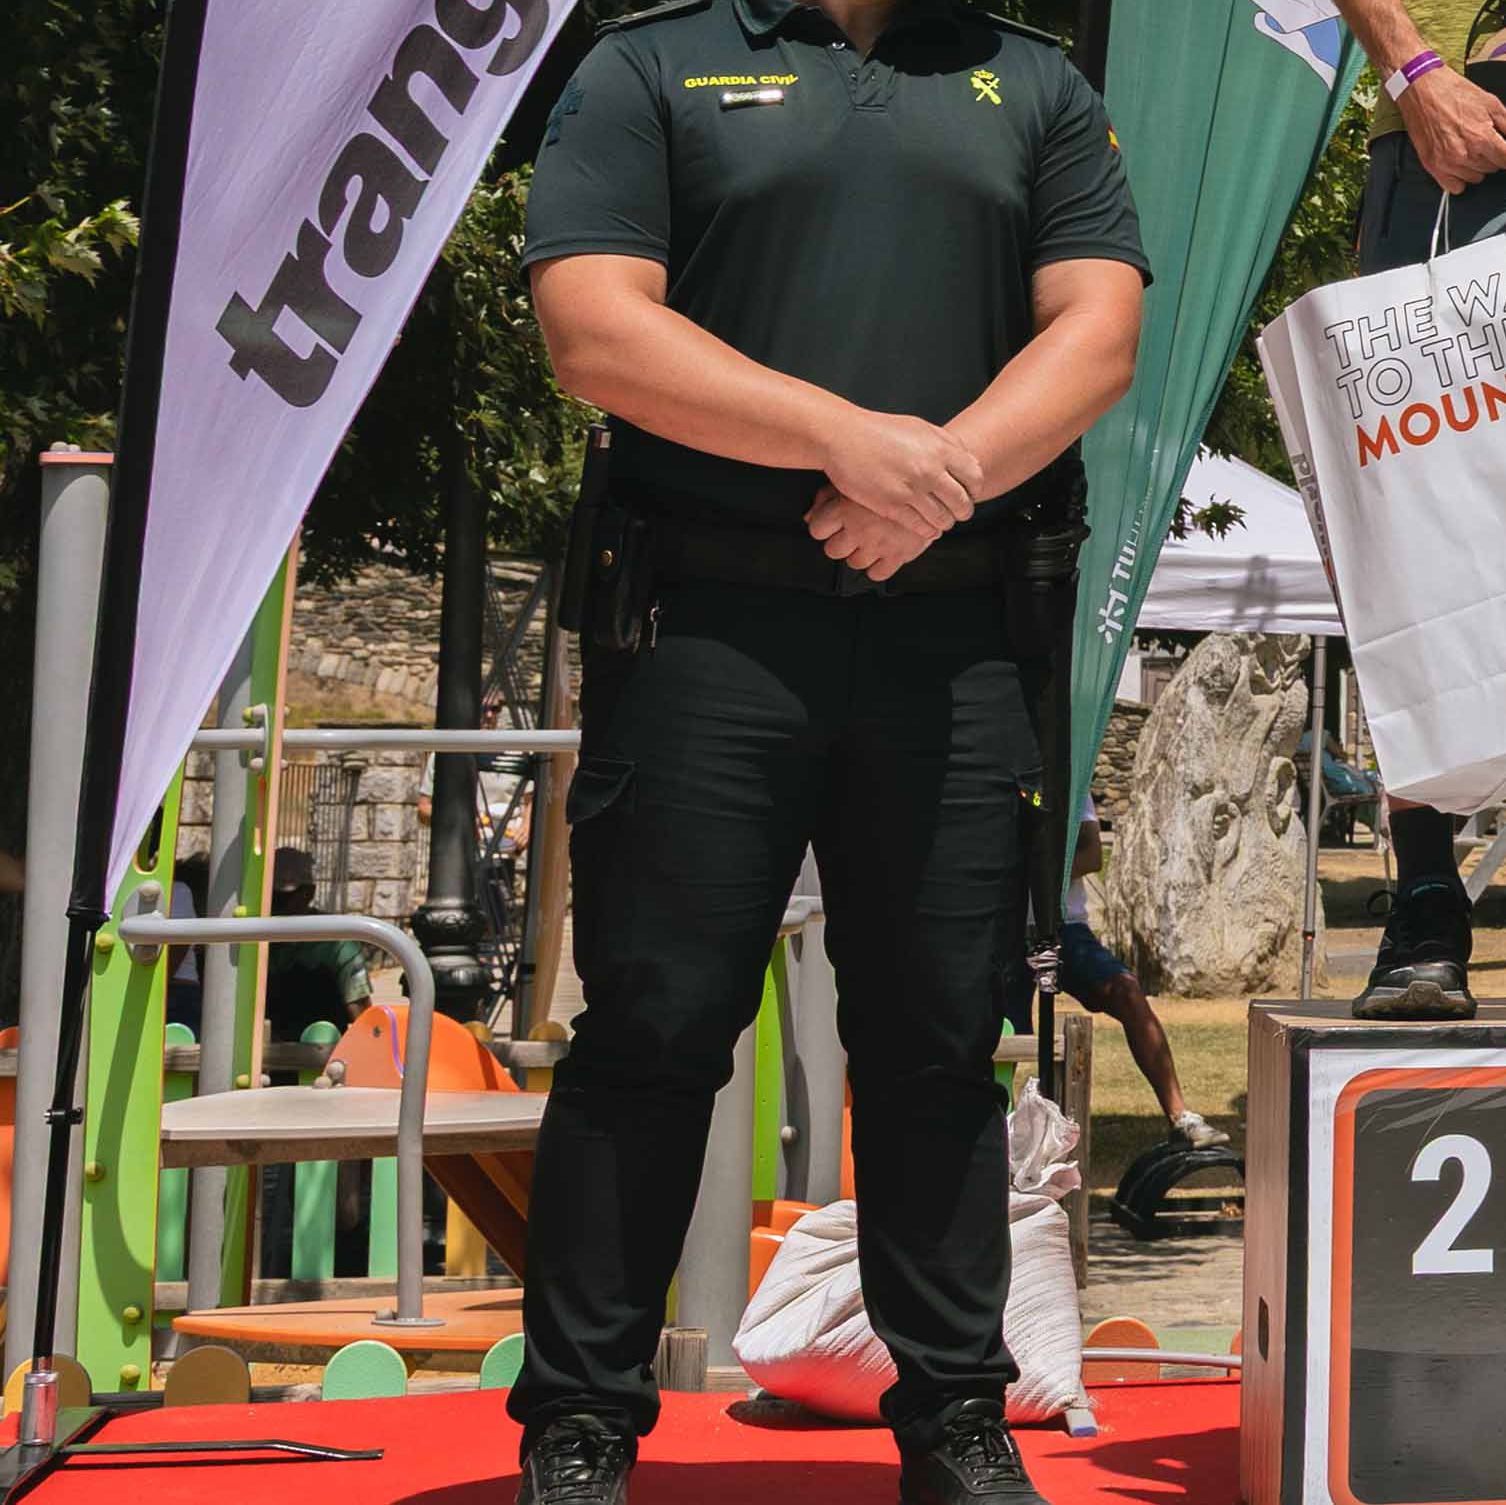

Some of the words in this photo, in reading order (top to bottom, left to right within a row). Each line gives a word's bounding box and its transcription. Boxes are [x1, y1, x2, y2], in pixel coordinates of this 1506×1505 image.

[684, 76, 757, 88] GUARDIA
[760, 73, 799, 85] CIVIL
[1325, 295, 1436, 369] THE
[1336, 366, 1412, 419] TO
[1411, 1133, 1494, 1275] 2
